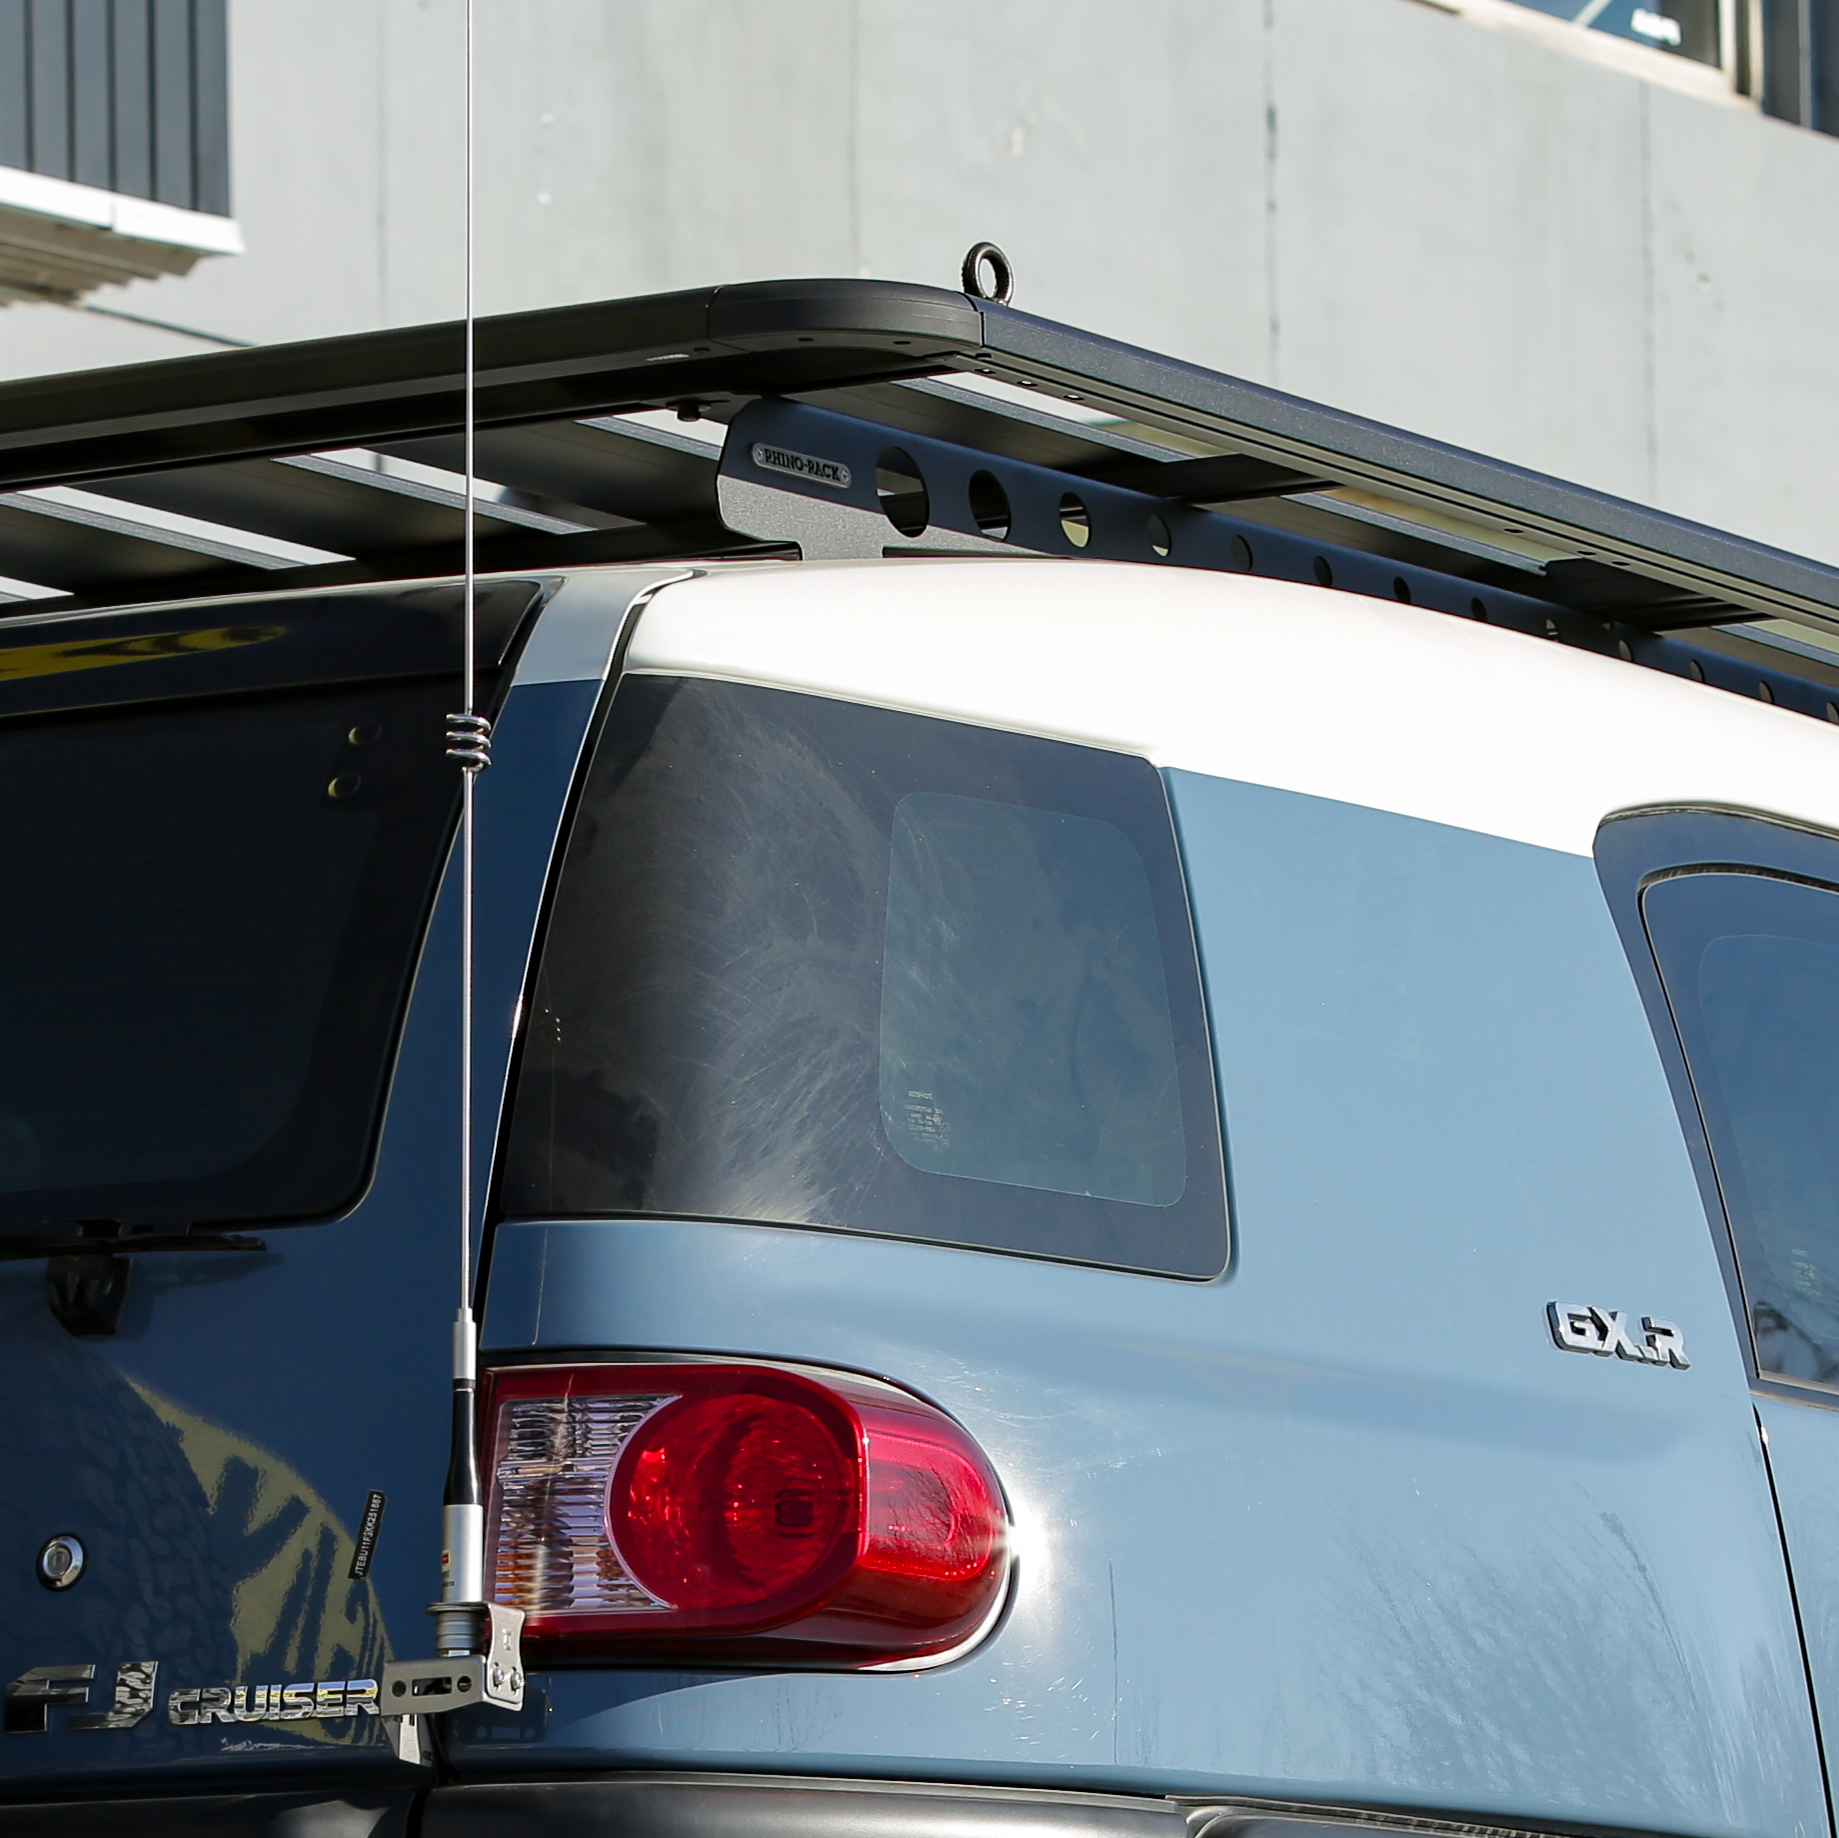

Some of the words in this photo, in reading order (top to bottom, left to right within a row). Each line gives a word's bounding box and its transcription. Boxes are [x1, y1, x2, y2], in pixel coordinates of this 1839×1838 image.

[764, 448, 841, 481] RHINO-RACK
[5, 1661, 158, 1733] FJ
[169, 1678, 380, 1726] CRUISER
